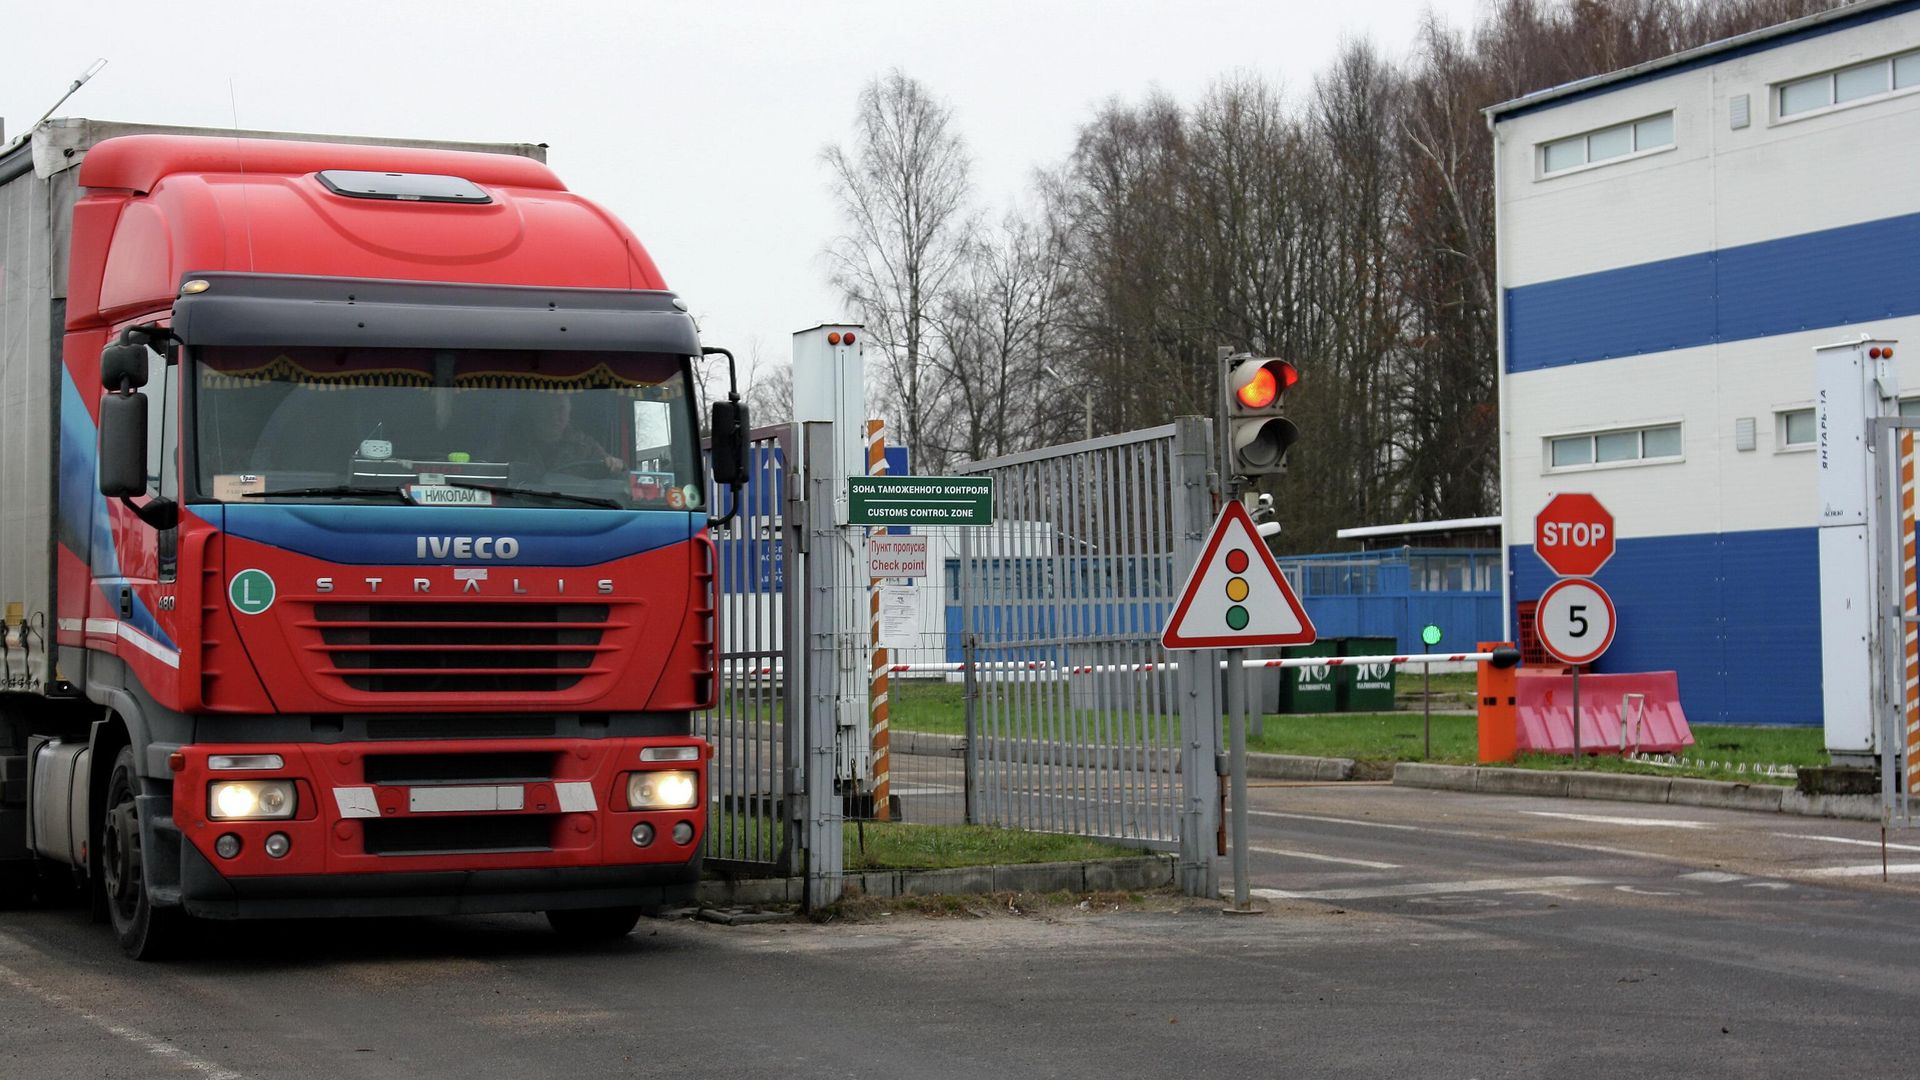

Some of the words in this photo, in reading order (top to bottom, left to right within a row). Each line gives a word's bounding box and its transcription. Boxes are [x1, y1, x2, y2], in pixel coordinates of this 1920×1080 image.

[852, 485, 876, 494] ЗОНА
[878, 485, 942, 494] ТАМОЖЕННОГО
[944, 486, 989, 494] КОНТРОЛЯ
[867, 508, 908, 517] CUSTOMS
[910, 509, 949, 517] CONTROL
[951, 509, 973, 517] ZONE
[1543, 521, 1606, 547] STOP
[416, 536, 519, 559] IVECO
[871, 540, 892, 556] Пункт
[893, 543, 925, 556] пропуска
[871, 560, 899, 570] Check
[901, 560, 924, 572] point
[244, 578, 261, 605] L
[316, 577, 614, 593] STRALIS
[1569, 605, 1588, 638] 5
